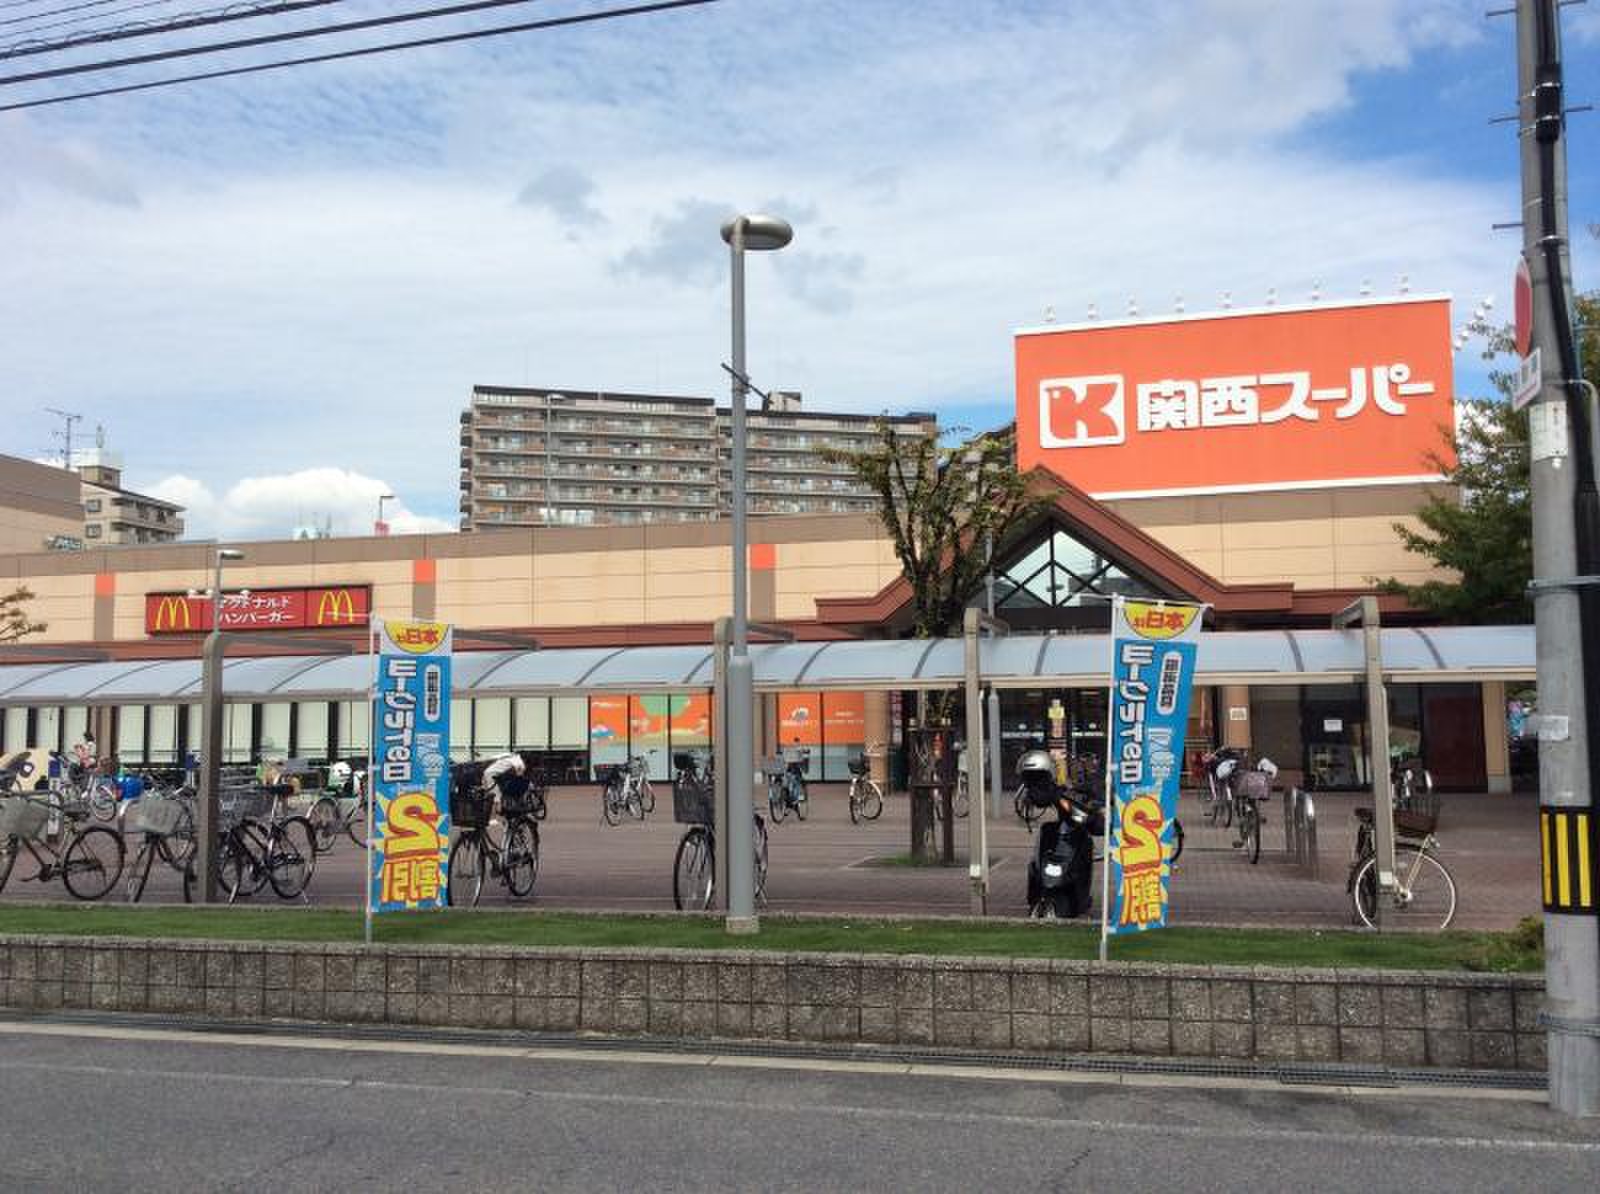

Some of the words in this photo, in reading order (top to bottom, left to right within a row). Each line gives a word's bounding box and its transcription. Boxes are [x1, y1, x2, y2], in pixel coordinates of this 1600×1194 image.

[1137, 363, 1436, 432] 関西スーパー
[219, 610, 295, 624] ハンバーガー
